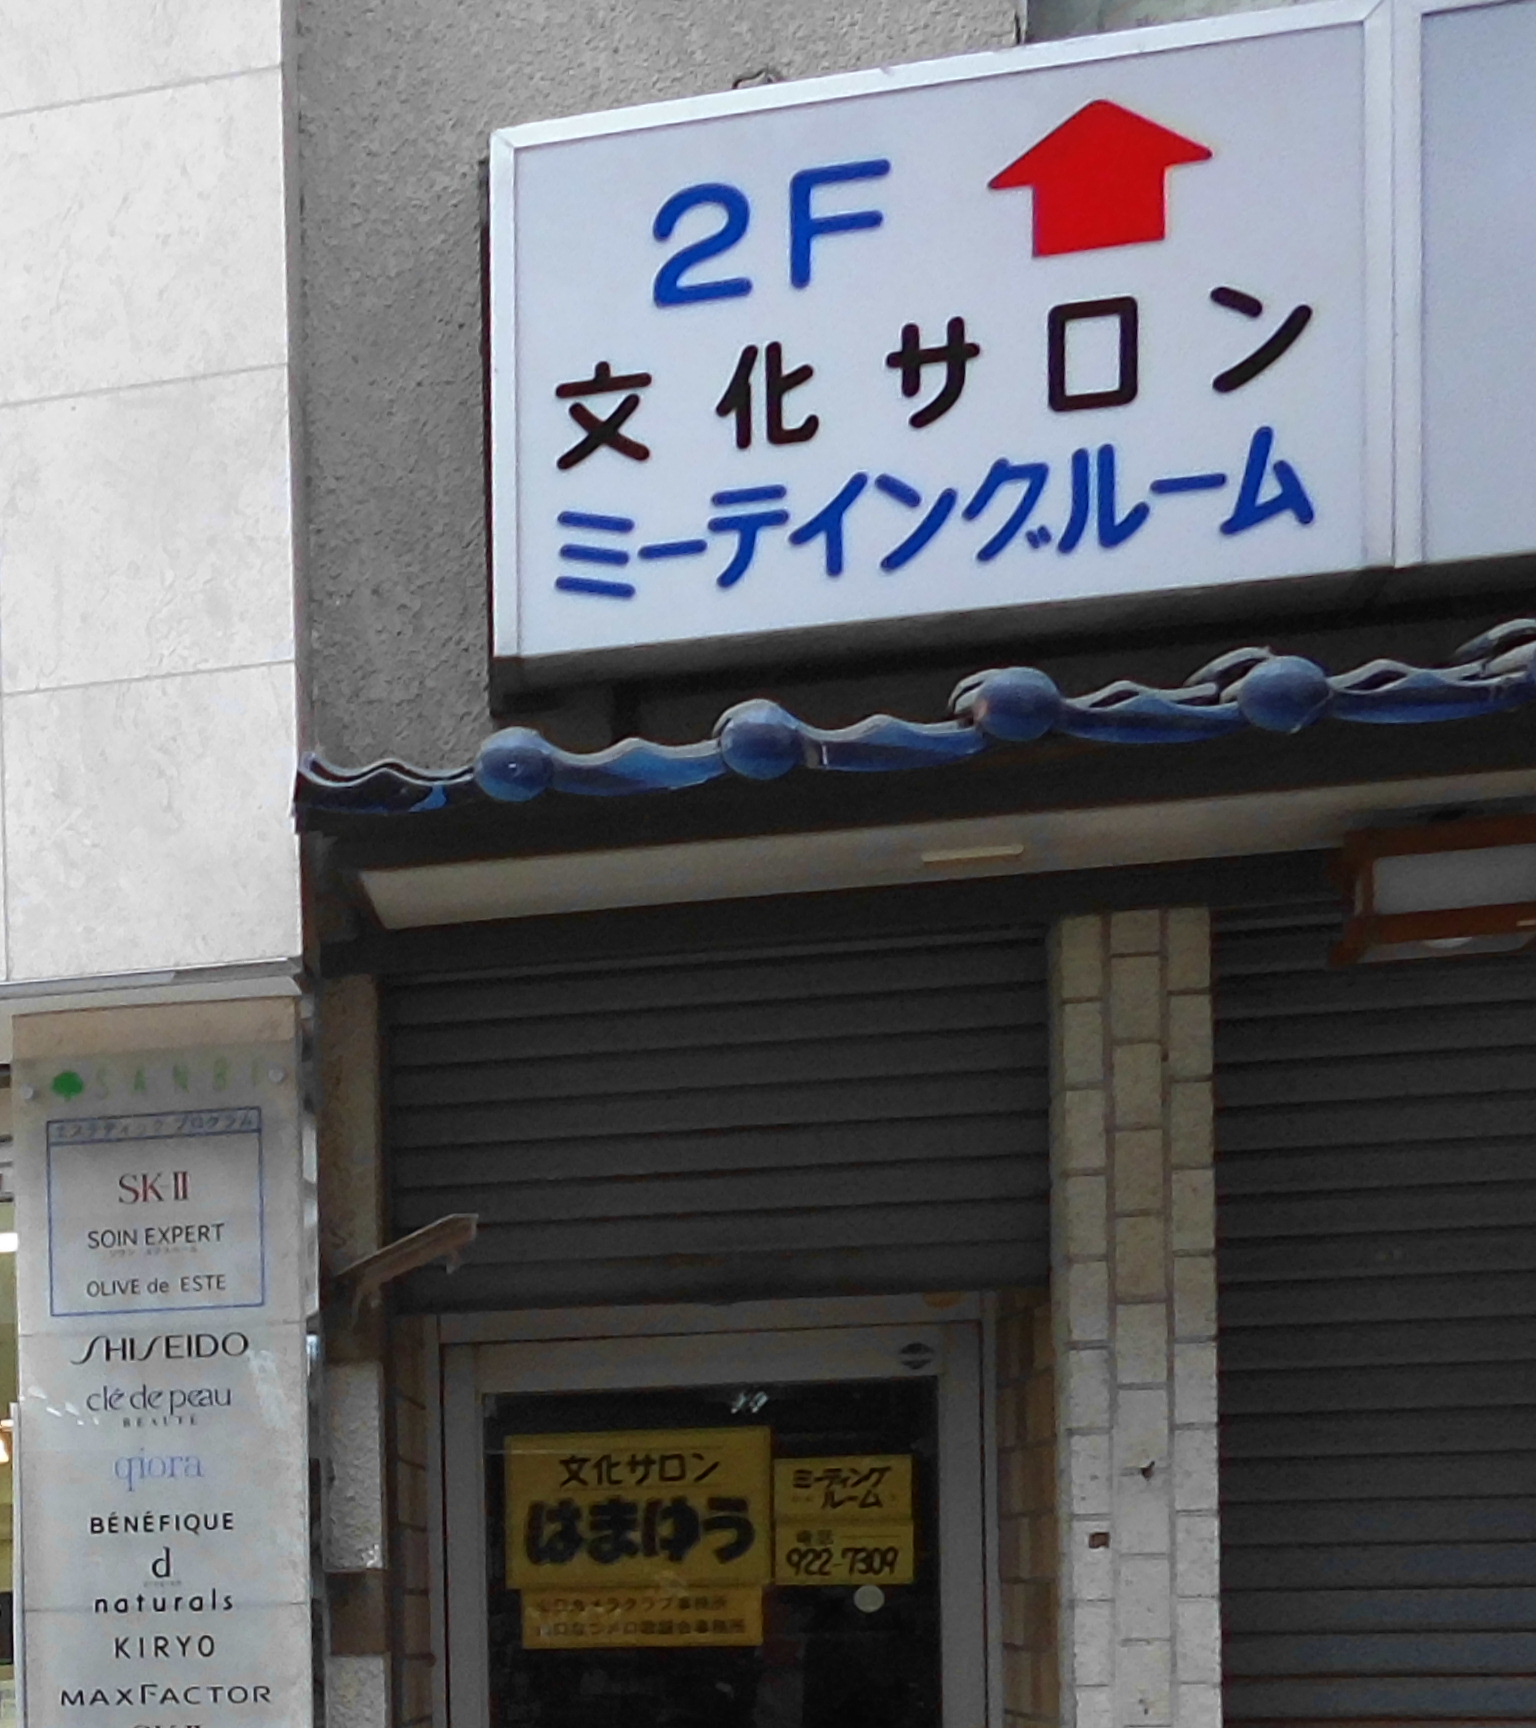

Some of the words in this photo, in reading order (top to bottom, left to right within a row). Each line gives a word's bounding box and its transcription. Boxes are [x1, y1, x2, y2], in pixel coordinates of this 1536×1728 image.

[653, 158, 892, 307] 2F
[555, 285, 1313, 471] 文化サロン
[88, 1228, 139, 1249] SOIN
[145, 1222, 225, 1244] EXPERT
[87, 1278, 141, 1298] OLIVE
[147, 1277, 171, 1295] de
[180, 1274, 227, 1293] ESTE
[71, 1331, 249, 1365] SHISEIDO
[87, 1385, 127, 1413] clé
[130, 1383, 163, 1411] de
[169, 1386, 232, 1416] peau
[114, 1447, 204, 1492] qiora
[560, 1453, 721, 1488] 文化サロン
[820, 1488, 884, 1511] ルーム
[90, 1512, 235, 1534] BÉNÉFIQUE
[526, 1494, 756, 1566] はまゆう
[151, 1546, 172, 1579] d
[785, 1545, 900, 1577] 922-7309
[94, 1588, 234, 1614] naturals
[115, 1634, 216, 1659] KIRYO
